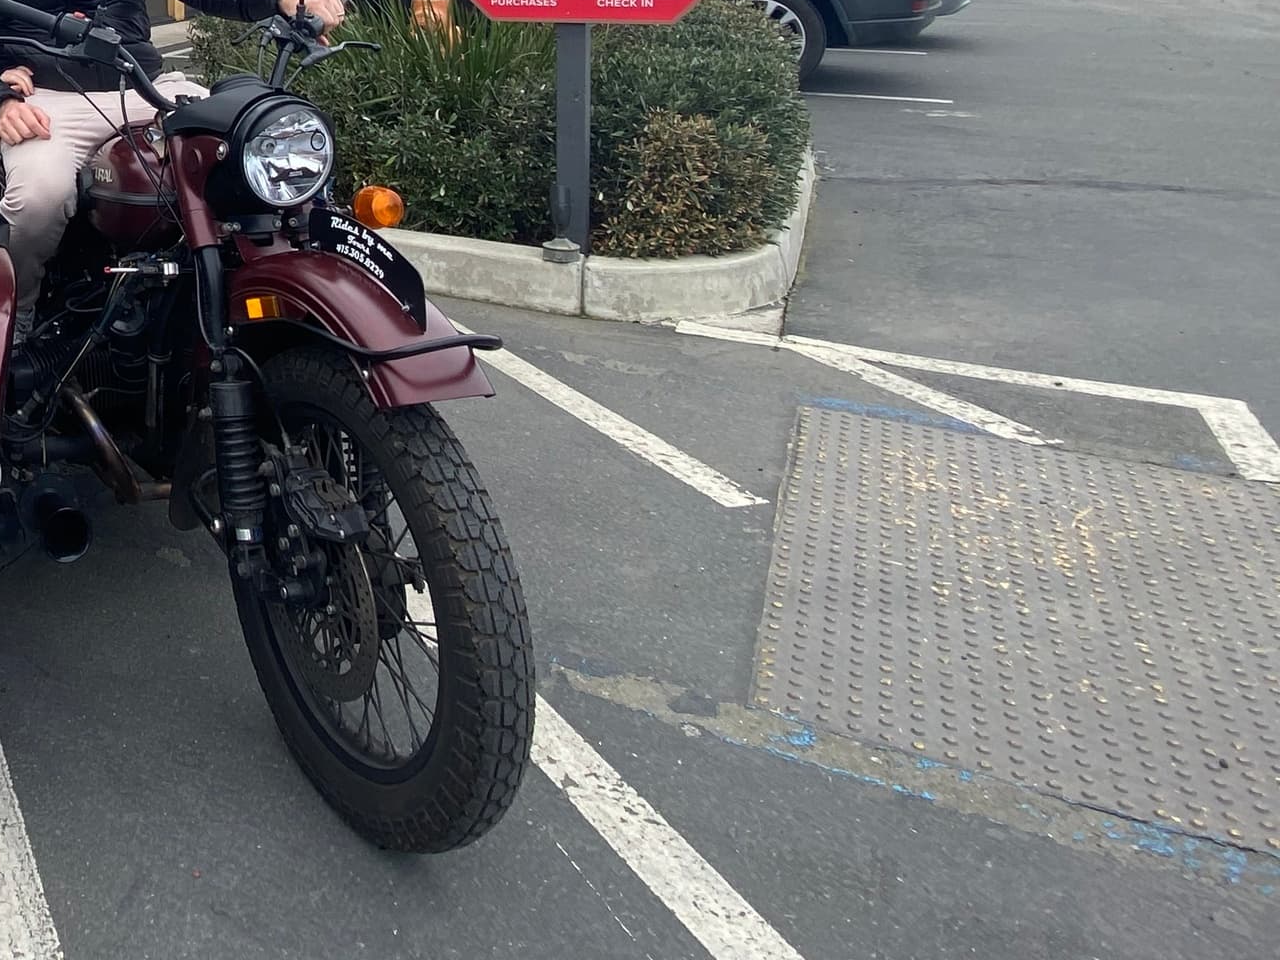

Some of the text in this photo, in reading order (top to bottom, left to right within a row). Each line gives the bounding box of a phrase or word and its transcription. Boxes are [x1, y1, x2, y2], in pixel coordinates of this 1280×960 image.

[641, 0, 654, 8] IN
[330, 216, 394, 262] Rides by me
[347, 234, 370, 255] Tours
